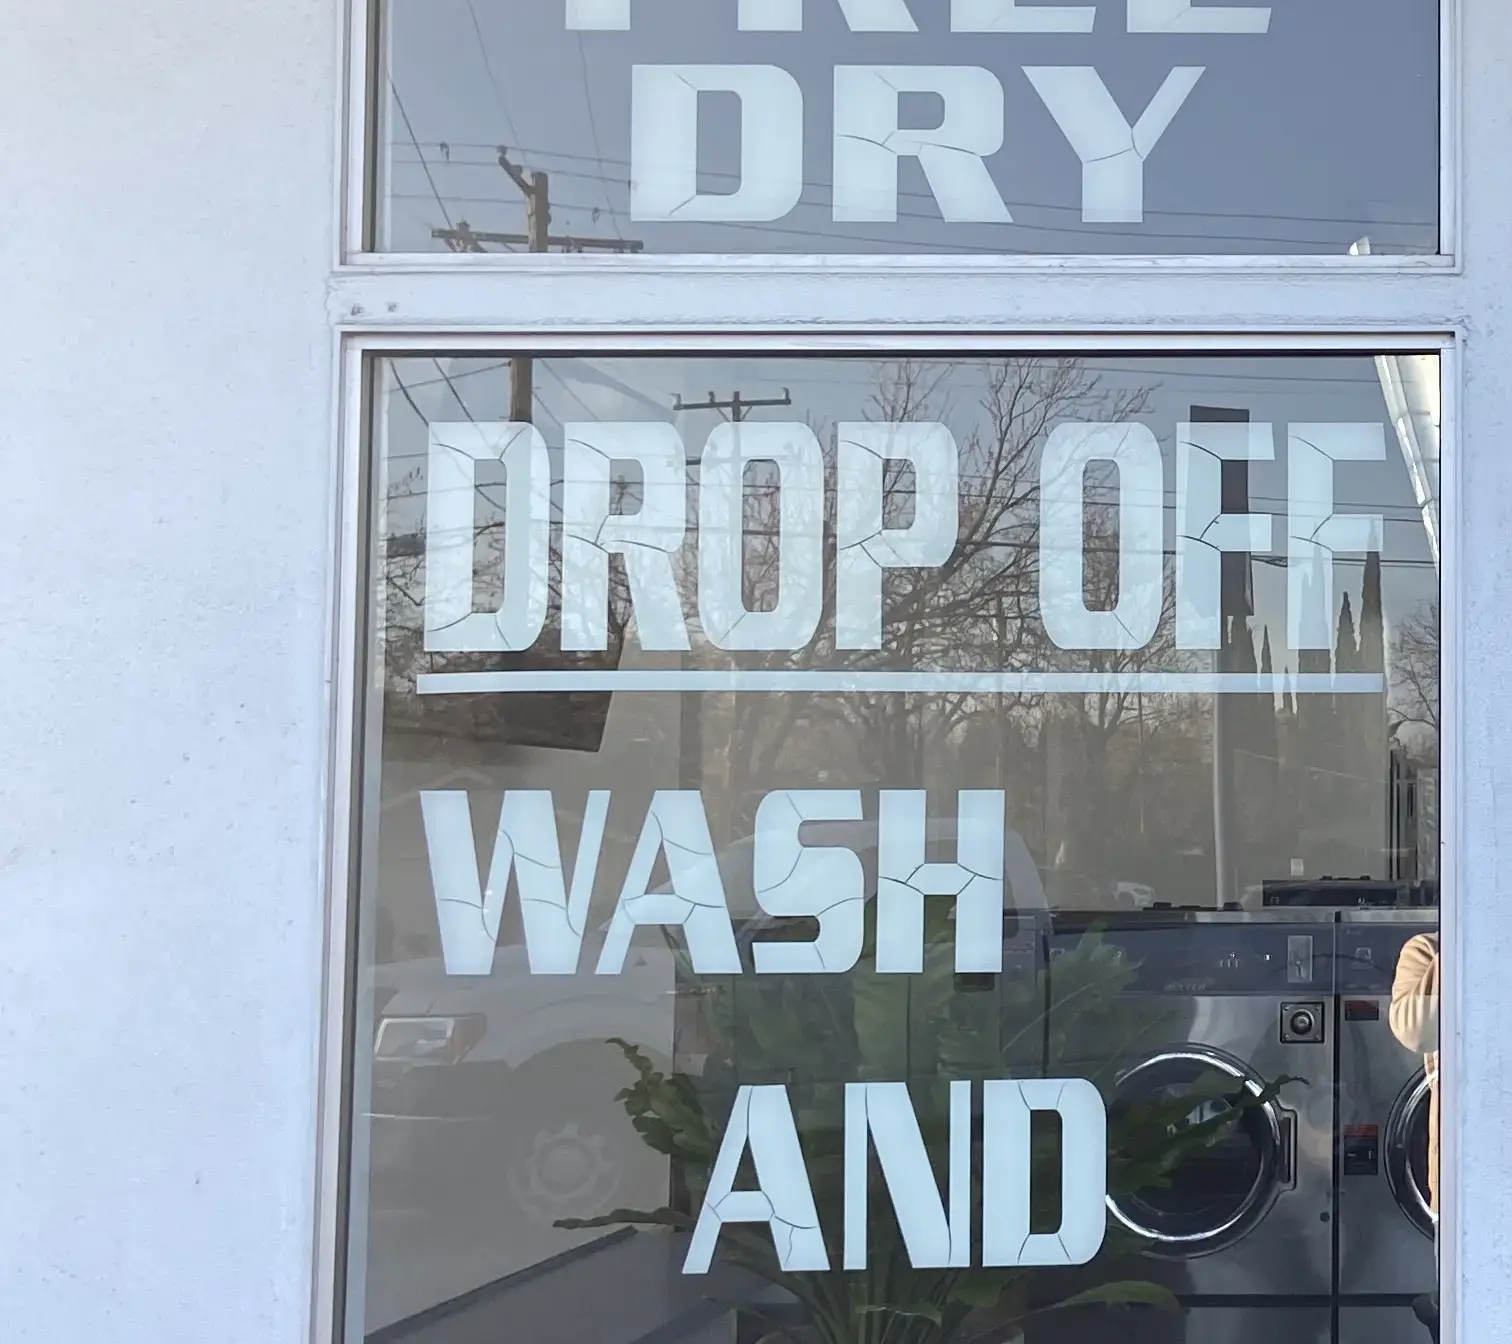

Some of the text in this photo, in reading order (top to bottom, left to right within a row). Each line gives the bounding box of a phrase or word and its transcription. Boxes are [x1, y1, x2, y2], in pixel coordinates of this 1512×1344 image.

[631, 64, 1207, 223] DRY
[423, 421, 1386, 652] DROP OFF
[420, 789, 1005, 975] WASH
[681, 1078, 1108, 1274] AND
